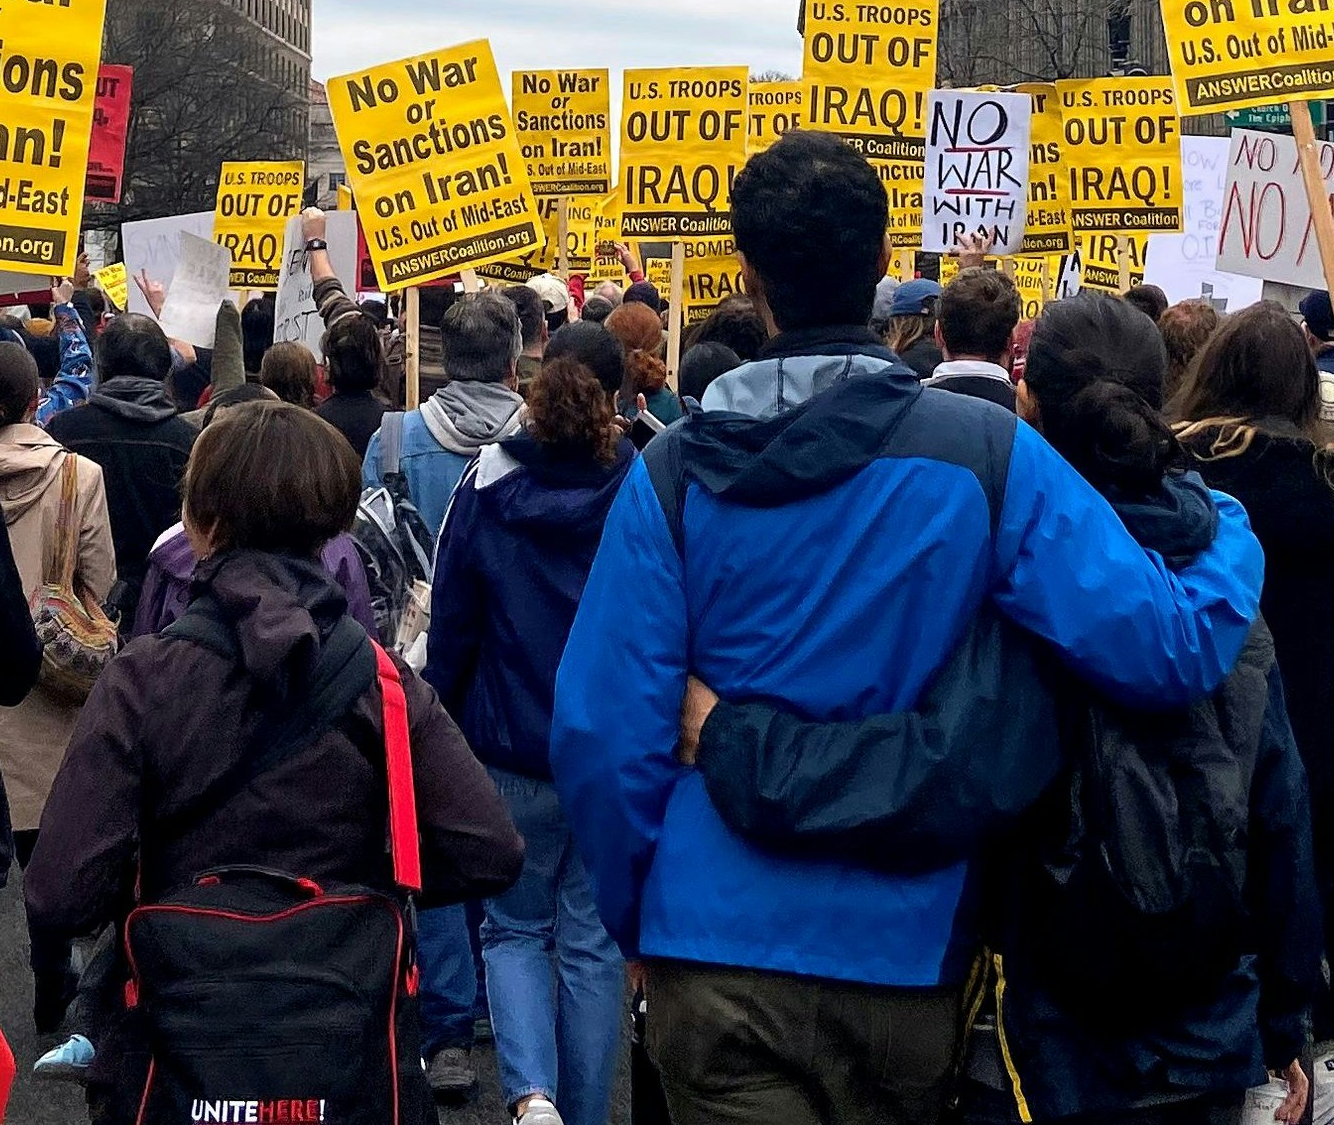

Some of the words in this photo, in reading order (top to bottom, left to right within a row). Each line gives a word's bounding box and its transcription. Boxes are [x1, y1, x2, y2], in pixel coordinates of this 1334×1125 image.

[813, 3, 850, 22] U.S.
[856, 5, 932, 26] TROOPS
[812, 32, 880, 65] OUT
[888, 36, 932, 68] OF
[1181, 34, 1222, 66] U.S.
[1227, 31, 1262, 60] Out
[1268, 27, 1285, 55] of
[97, 77, 120, 98] UT
[346, 75, 398, 112] No
[405, 56, 478, 95] War
[522, 73, 551, 94] No
[557, 73, 600, 93] War
[629, 82, 663, 100] U.S.
[669, 80, 742, 98] TROOPS
[551, 96, 570, 109] or
[749, 92, 802, 105] TROOPS
[1063, 91, 1098, 108] U.S.
[1102, 88, 1173, 107] TROOPS
[406, 98, 436, 124] or
[517, 109, 606, 131] Sanctions
[810, 85, 923, 137] IRAQ!
[627, 110, 691, 142] OUT
[699, 110, 742, 141] OF
[930, 99, 1008, 149] NO
[1065, 117, 1126, 145] OUT
[1135, 116, 1176, 144] OF
[353, 114, 505, 175] Sanctions
[521, 144, 544, 158] on
[552, 136, 602, 157] Iran!
[867, 140, 925, 157] Coalition
[1234, 135, 1276, 172] NO
[225, 172, 246, 185] U.S.
[251, 172, 300, 186] TROOPS
[538, 163, 554, 176] Out
[556, 162, 565, 176] of
[568, 162, 607, 175] Mid-East
[938, 149, 1022, 189] WAR
[374, 188, 416, 218] on
[422, 152, 511, 204] Iran!
[626, 164, 735, 211] IRAQ!
[1070, 166, 1170, 207] IRAQ!
[221, 193, 264, 217] OUT
[268, 193, 298, 217] OF
[934, 196, 1015, 220] WITH
[375, 225, 408, 251] U.S.
[410, 218, 439, 241] Out
[443, 209, 458, 231] of
[462, 192, 528, 225] Mid-East
[622, 217, 676, 232] ANSWER
[1124, 212, 1179, 226] Coalition
[1219, 180, 1285, 260] NO
[942, 222, 1008, 246] IRAN
[391, 229, 529, 277] ANSWERCoalition.org
